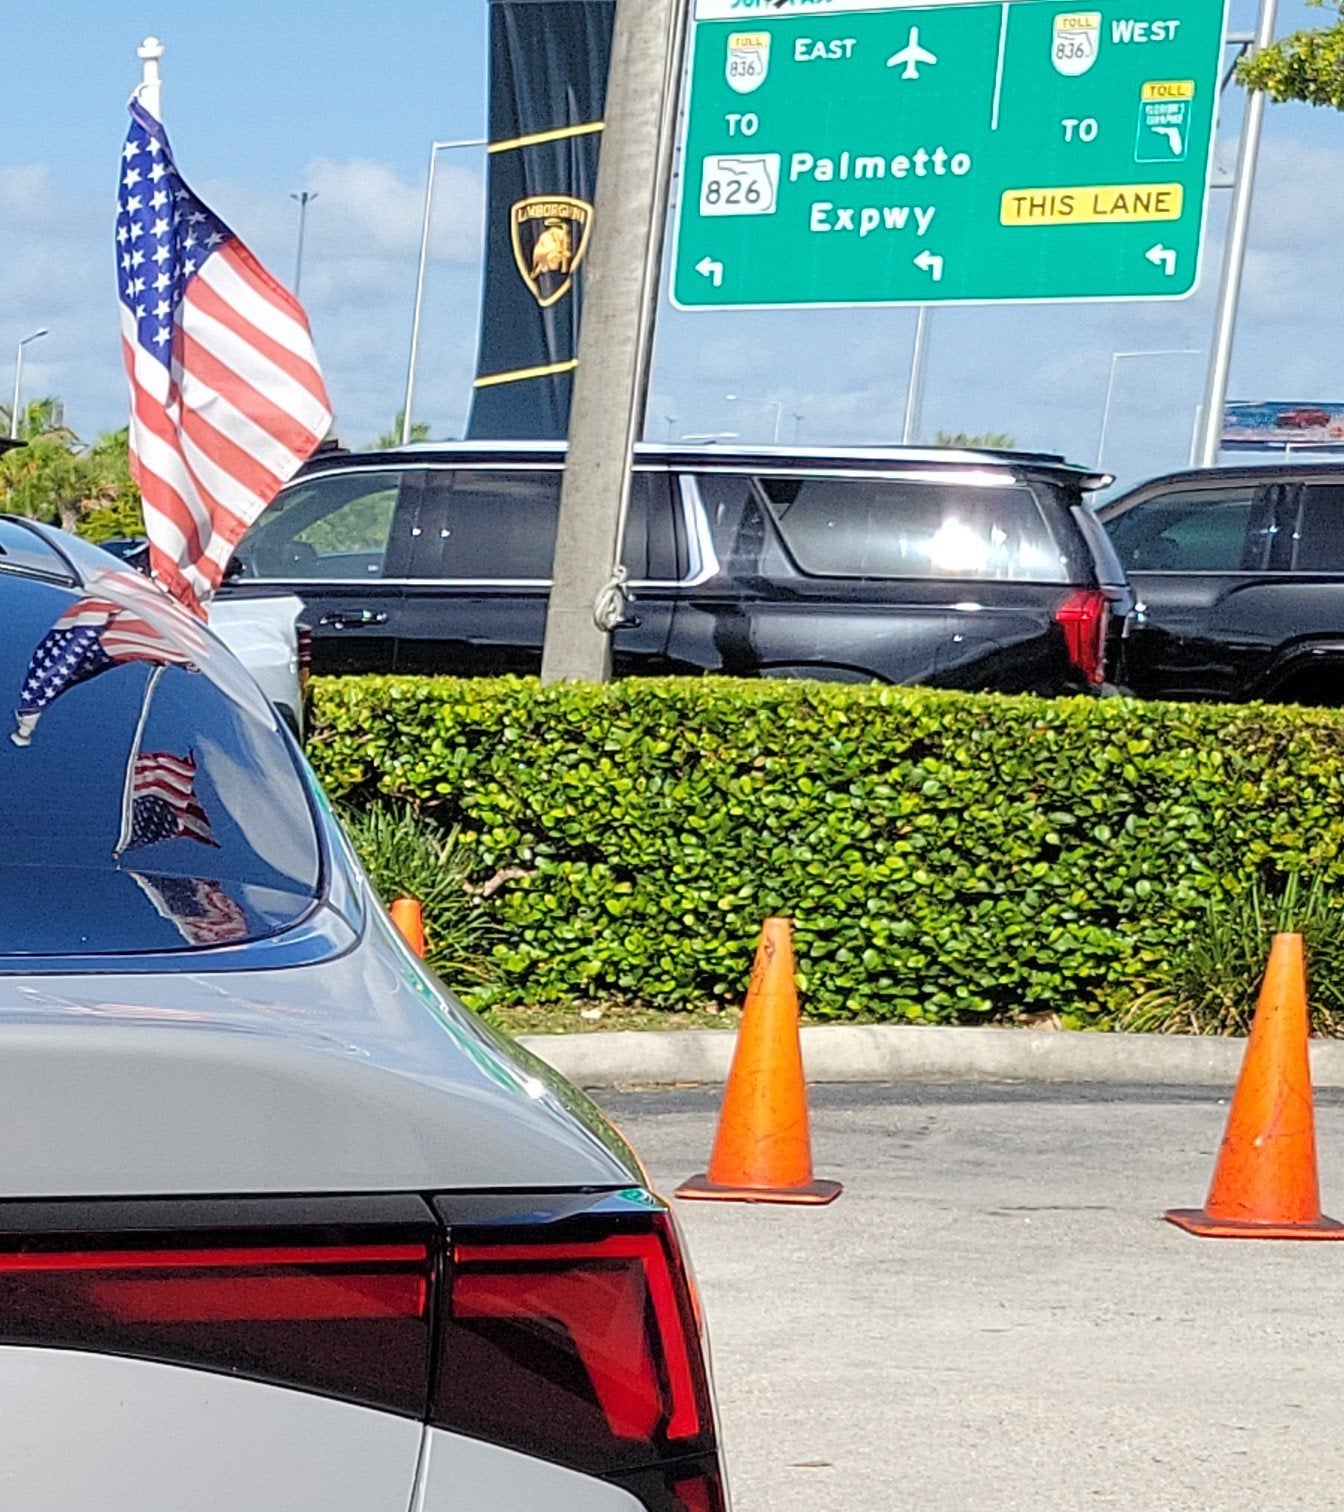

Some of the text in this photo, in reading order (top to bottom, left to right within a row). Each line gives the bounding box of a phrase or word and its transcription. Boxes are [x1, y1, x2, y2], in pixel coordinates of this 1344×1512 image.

[1062, 17, 1093, 28] TOLL
[1111, 18, 1181, 44] WEST
[794, 38, 857, 62] EAST
[1055, 43, 1085, 60] 836
[729, 61, 755, 77] 836
[1149, 84, 1186, 97] TOLL
[725, 112, 759, 137] TO
[1061, 118, 1099, 143] TO
[789, 145, 972, 183] Palmetto
[705, 179, 762, 205] 826
[1012, 191, 1173, 219] THIS LANE
[809, 201, 937, 238] Expwy
